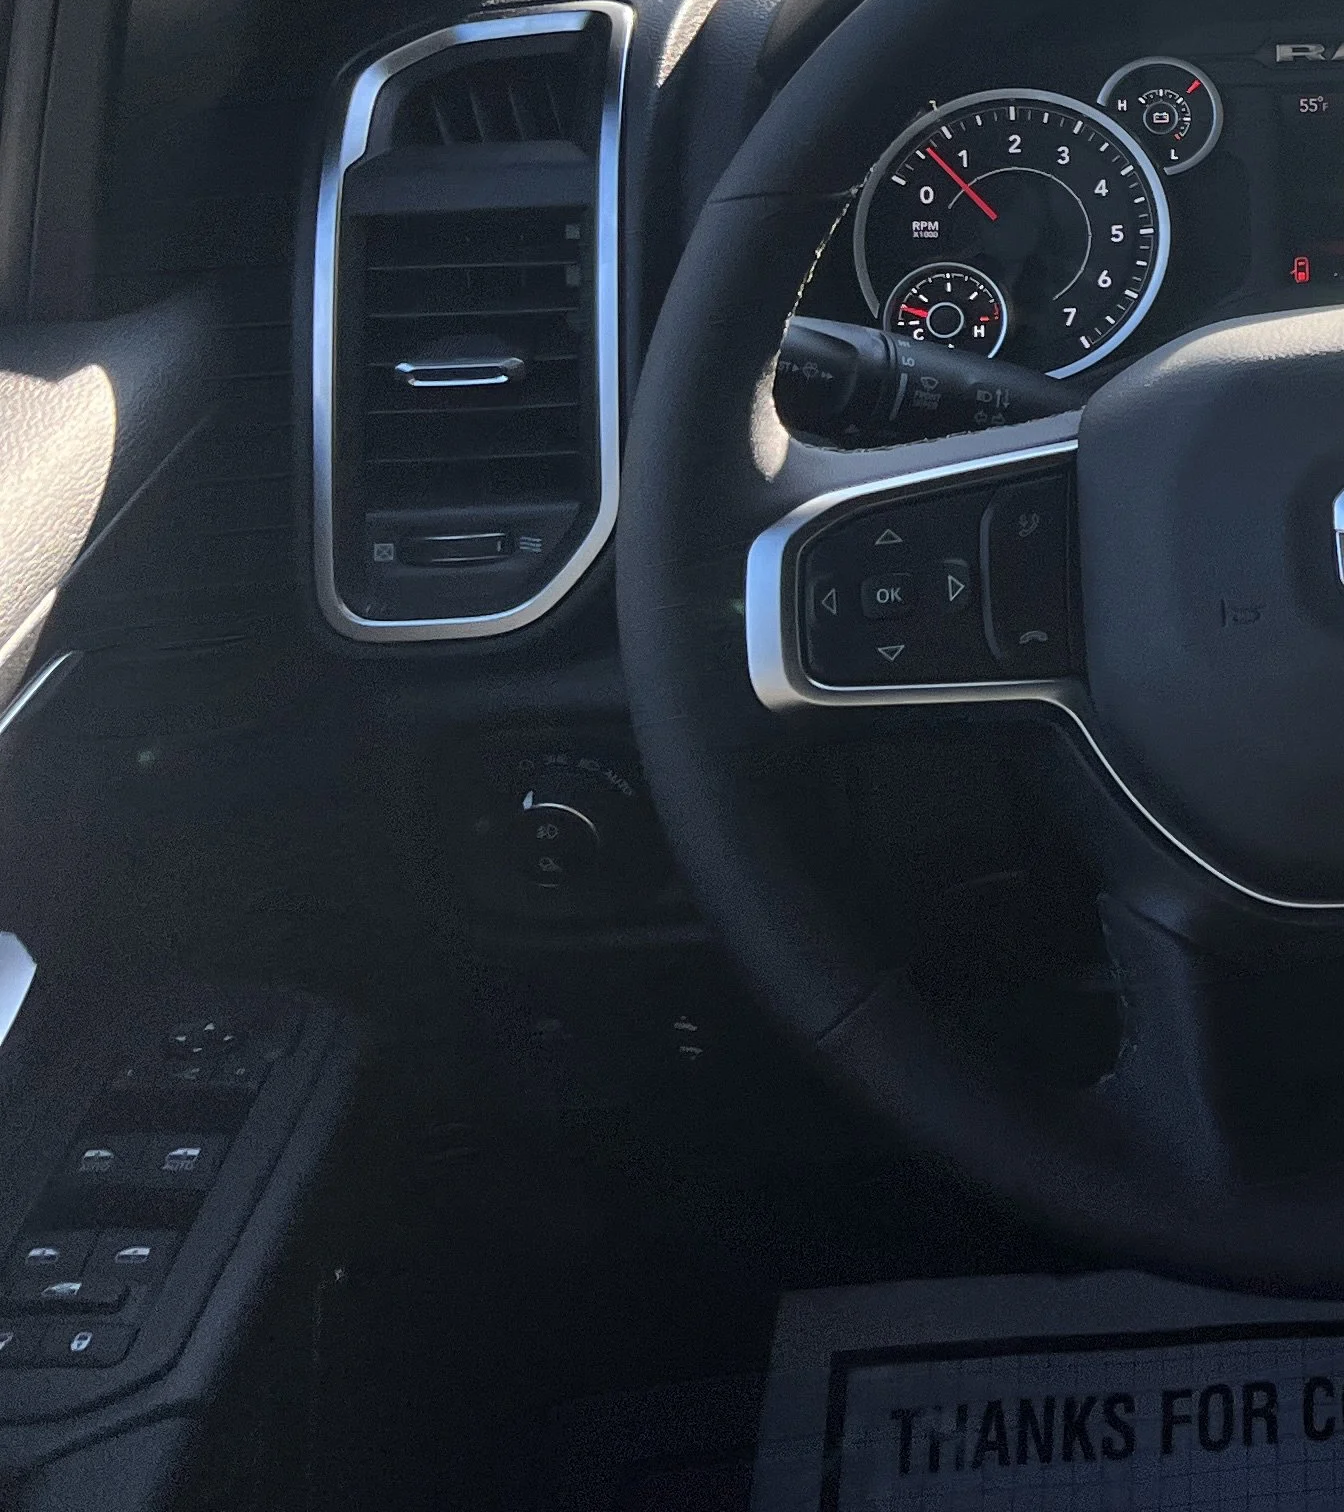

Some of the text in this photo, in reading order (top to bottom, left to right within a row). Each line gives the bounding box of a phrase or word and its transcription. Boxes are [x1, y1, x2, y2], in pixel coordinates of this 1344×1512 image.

[1117, 99, 1127, 111] H
[1007, 135, 1022, 154] 2
[957, 149, 969, 168] 1
[1057, 146, 1071, 165] 3
[1170, 148, 1179, 160] L
[919, 187, 934, 204] 0
[1093, 179, 1109, 197] 4
[911, 221, 939, 231] RPM
[1110, 224, 1125, 242] 5
[1098, 269, 1112, 288] 6
[1063, 307, 1078, 326] 7
[912, 328, 925, 342] C
[973, 324, 986, 338] H
[876, 587, 902, 603] OK
[889, 1392, 1137, 1475] THANKS
[1160, 1380, 1281, 1458] FOR
